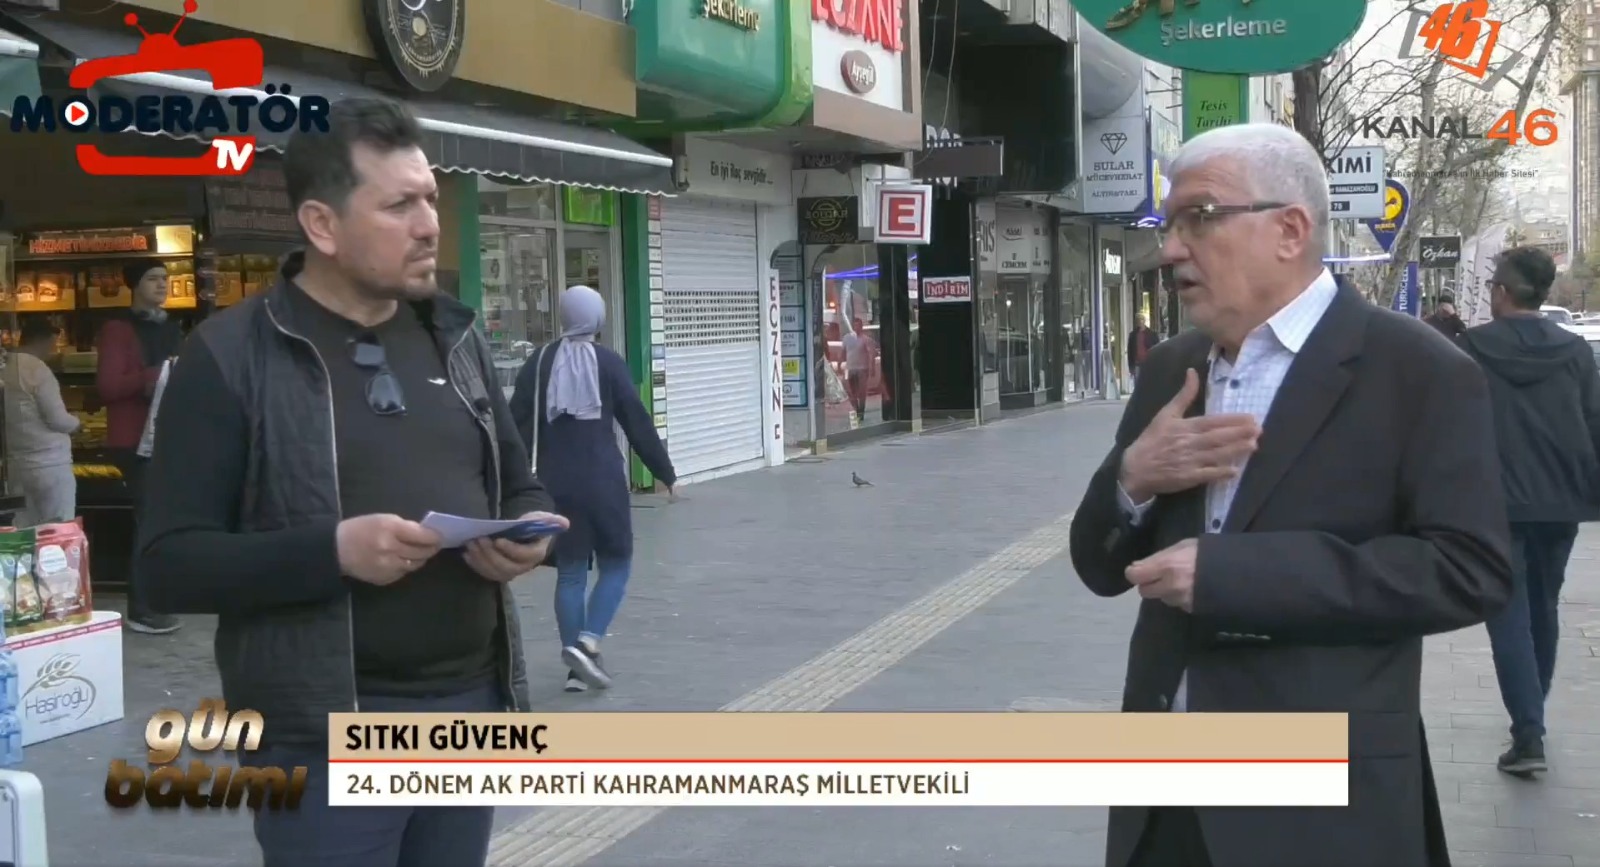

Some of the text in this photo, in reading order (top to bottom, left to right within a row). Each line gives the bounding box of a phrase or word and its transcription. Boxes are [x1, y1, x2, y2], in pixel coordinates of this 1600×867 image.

[1161, 16, 1288, 46] Şekerleme
[1200, 100, 1227, 110] Tesis
[1196, 115, 1232, 128] Tarihi
[710, 161, 719, 176] En
[720, 162, 729, 181] iyi
[1094, 161, 1134, 171] SULAR
[889, 198, 915, 231] E
